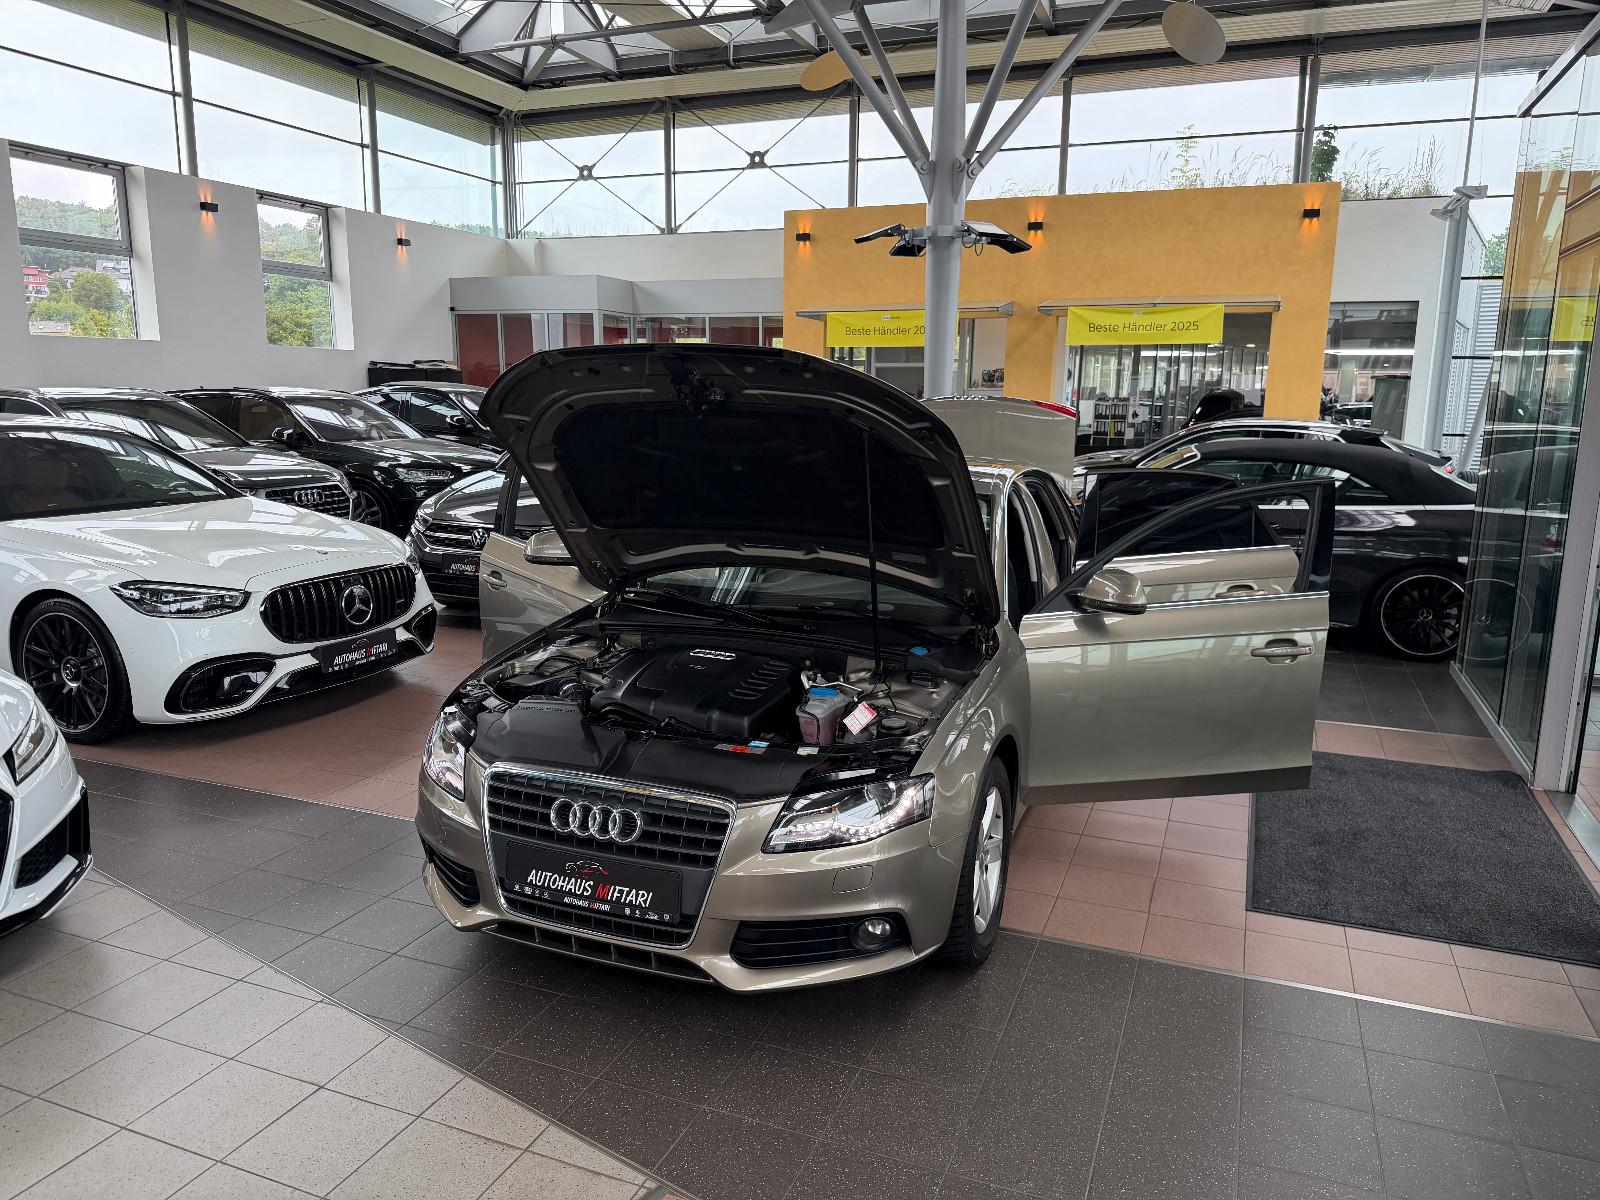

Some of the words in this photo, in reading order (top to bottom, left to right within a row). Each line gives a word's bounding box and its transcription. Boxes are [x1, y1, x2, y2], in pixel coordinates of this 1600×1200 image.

[845, 326, 872, 336] Beste
[873, 325, 912, 336] Händler
[913, 325, 926, 335] 20
[1088, 322, 1119, 333] Beste
[1122, 321, 1167, 332] Händler
[1170, 320, 1199, 331] 2025
[450, 563, 476, 572] AUTOHAUS
[333, 648, 366, 666] AUTOHAUS
[527, 869, 594, 896] AUTOHAUS
[595, 883, 653, 908] MIFTARI
[563, 896, 590, 908] AUTOHAUS
